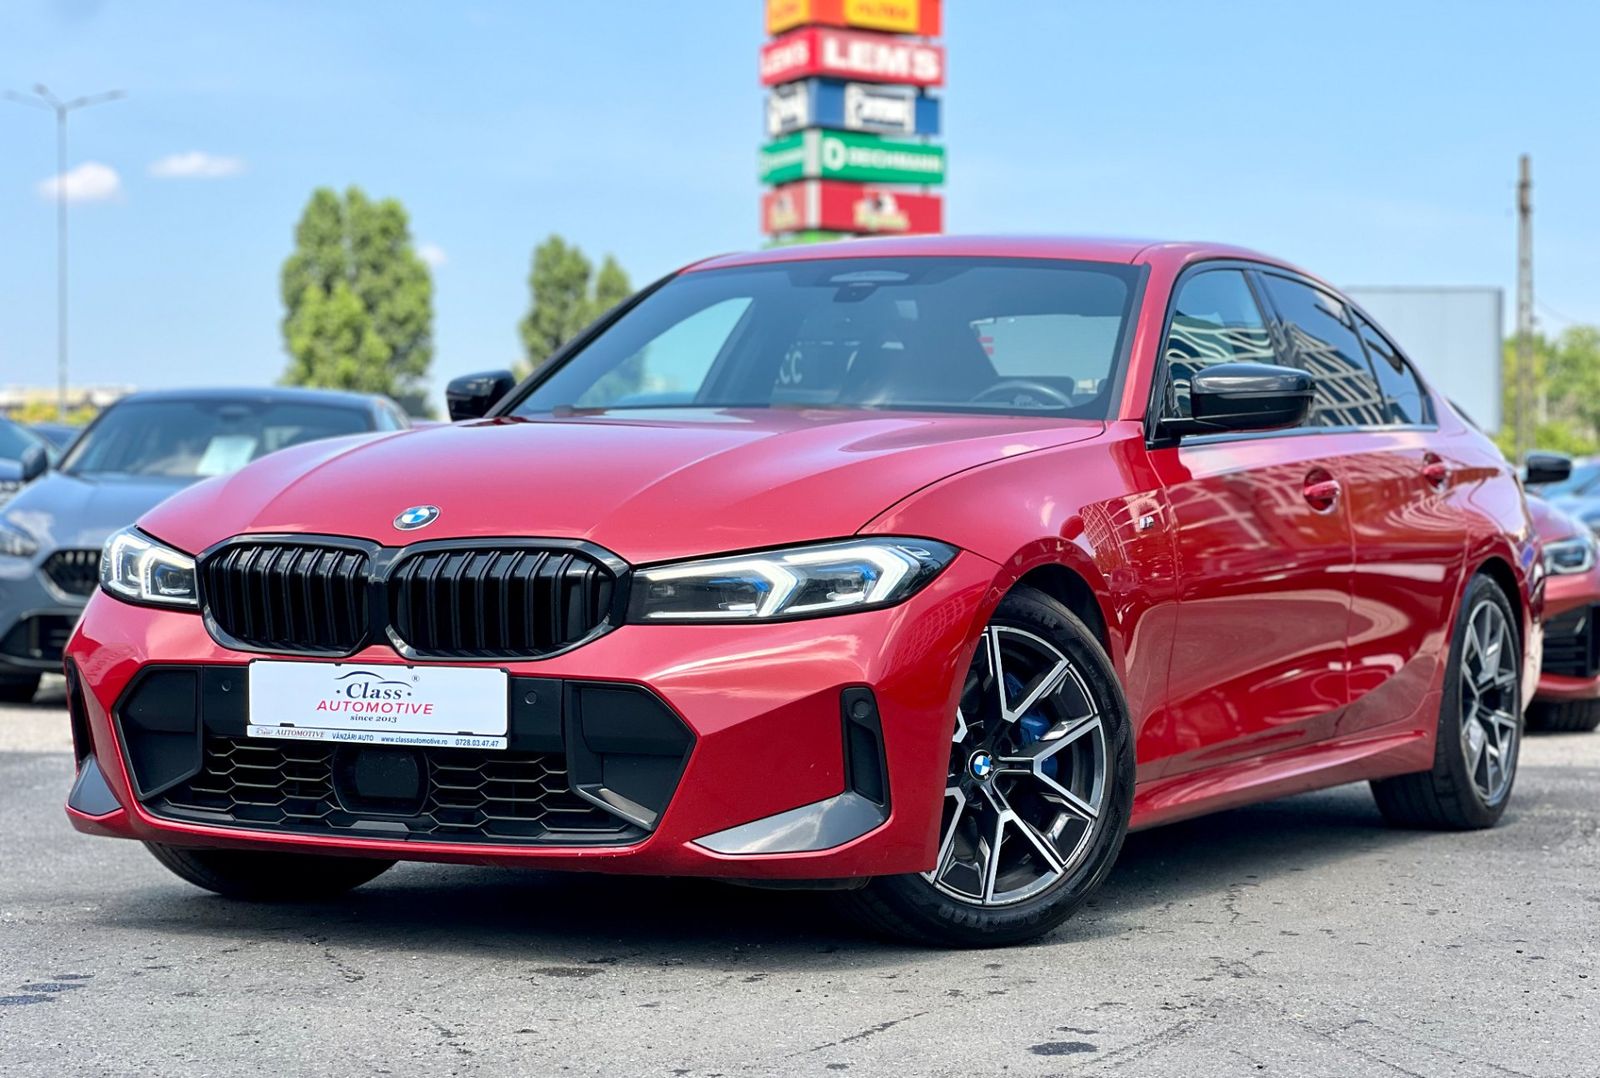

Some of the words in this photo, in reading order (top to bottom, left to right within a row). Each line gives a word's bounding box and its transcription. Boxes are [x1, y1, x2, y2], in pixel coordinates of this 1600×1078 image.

[346, 681, 403, 700] Class
[316, 700, 434, 715] AUTOMOTIVE
[350, 714, 374, 722] since
[375, 715, 398, 723] 2013
[275, 728, 325, 738] AUTOMOTIVE
[357, 733, 374, 742] AUTO
[381, 735, 448, 746] www.classautomotive.ro
